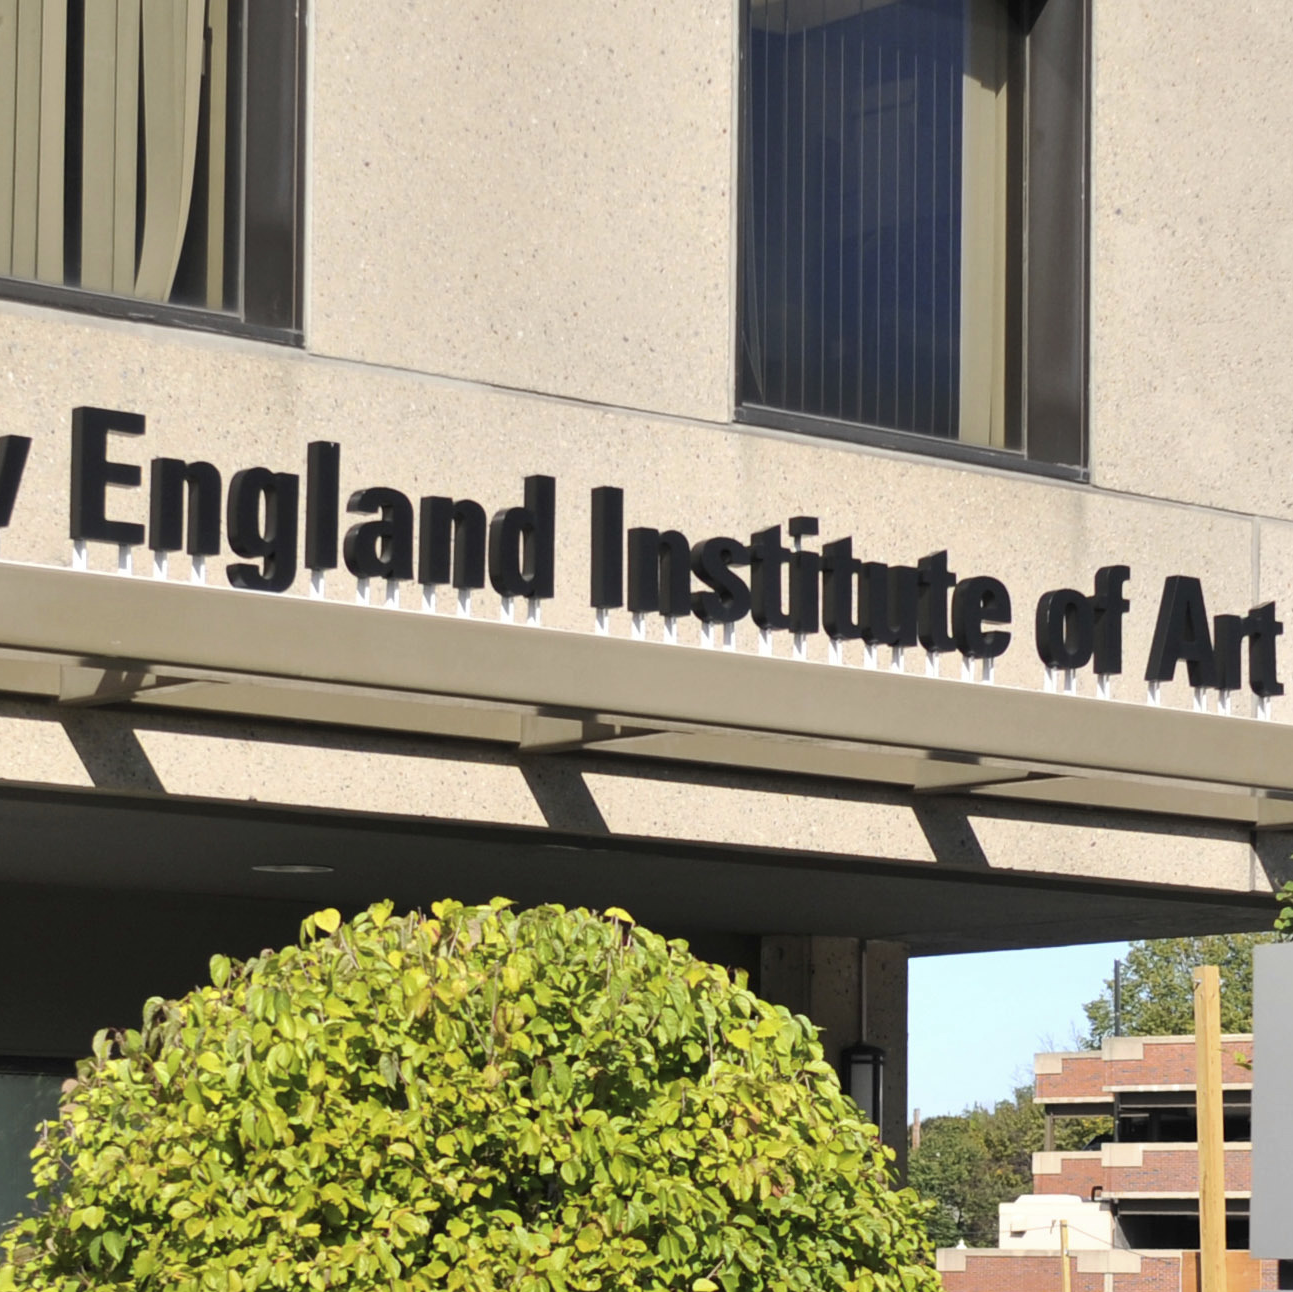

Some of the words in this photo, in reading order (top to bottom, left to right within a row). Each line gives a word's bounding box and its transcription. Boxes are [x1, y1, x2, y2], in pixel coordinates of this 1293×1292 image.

[69, 406, 557, 600] England
[590, 486, 1013, 660] Institute
[1035, 564, 1131, 676] of
[1144, 574, 1285, 698] Art
